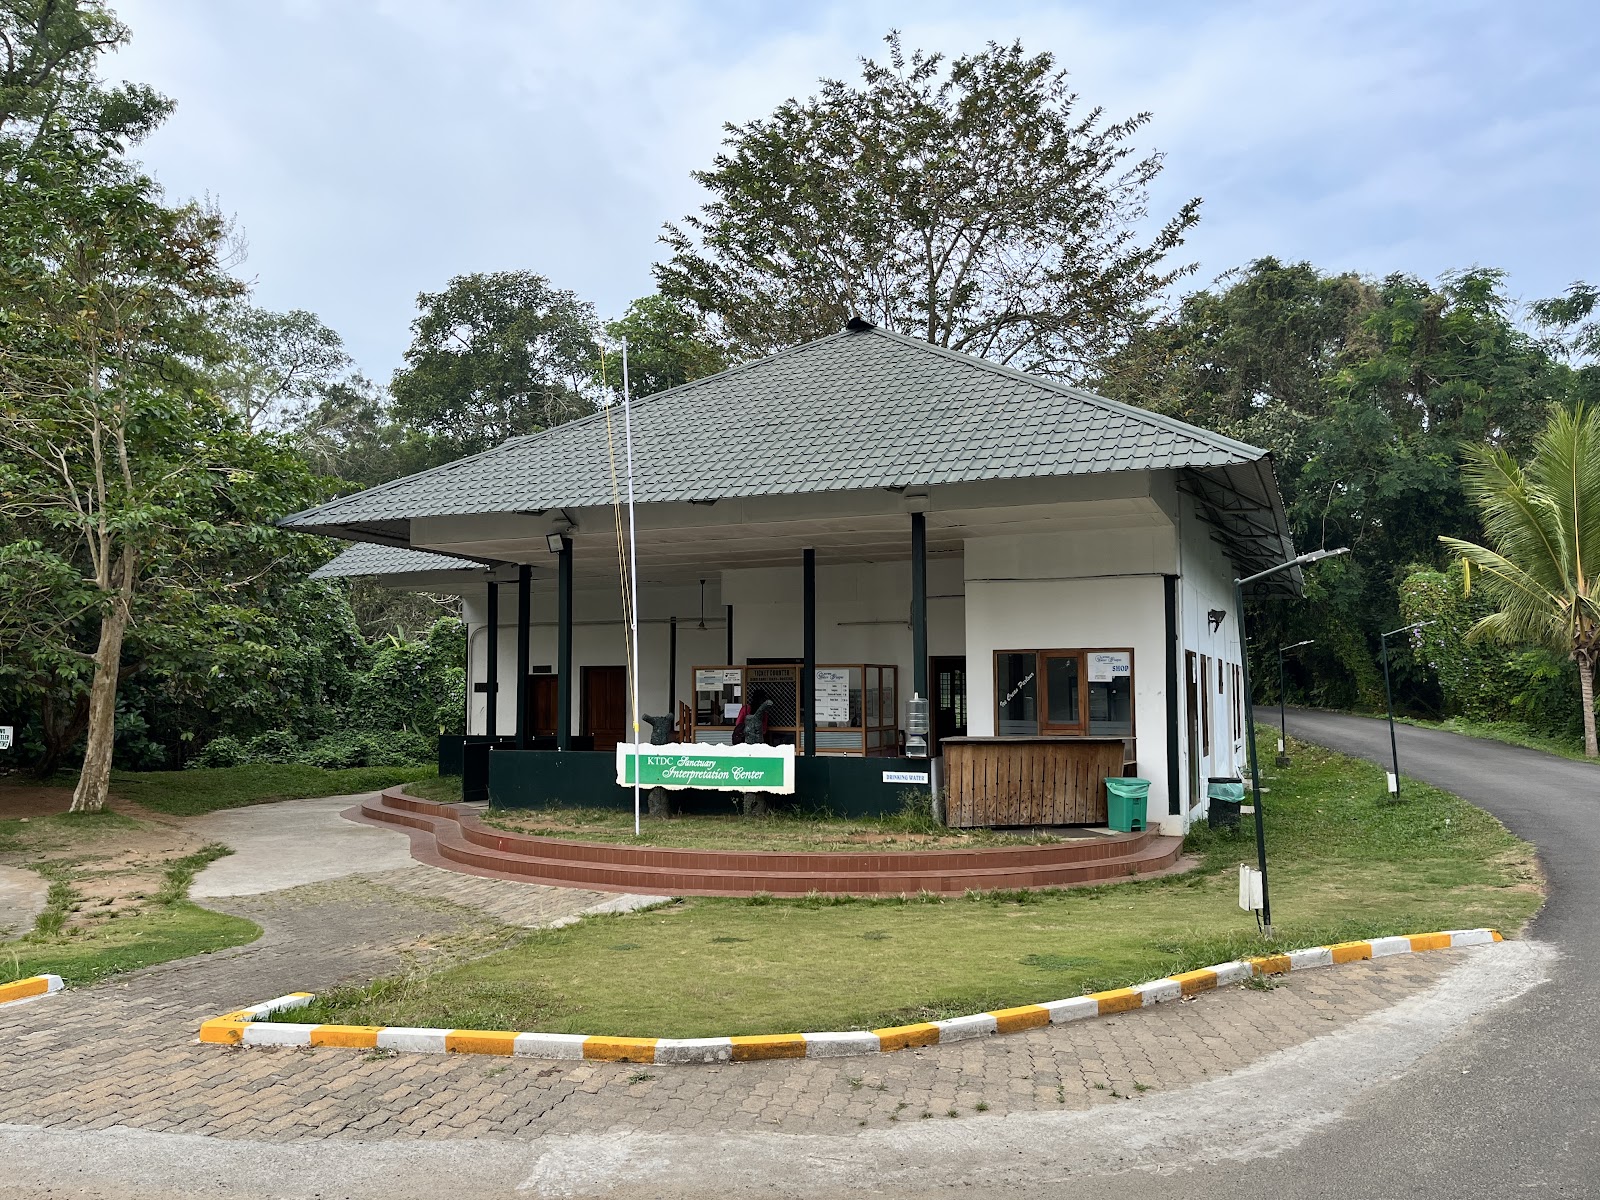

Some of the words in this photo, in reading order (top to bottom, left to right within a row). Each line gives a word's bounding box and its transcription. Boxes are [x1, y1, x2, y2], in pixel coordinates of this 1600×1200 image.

[754, 669, 769, 677] TICKET
[647, 756, 674, 765] KTDC
[677, 756, 717, 770] Sanctuary
[662, 766, 729, 784] Interpretation
[731, 767, 764, 780] Center
